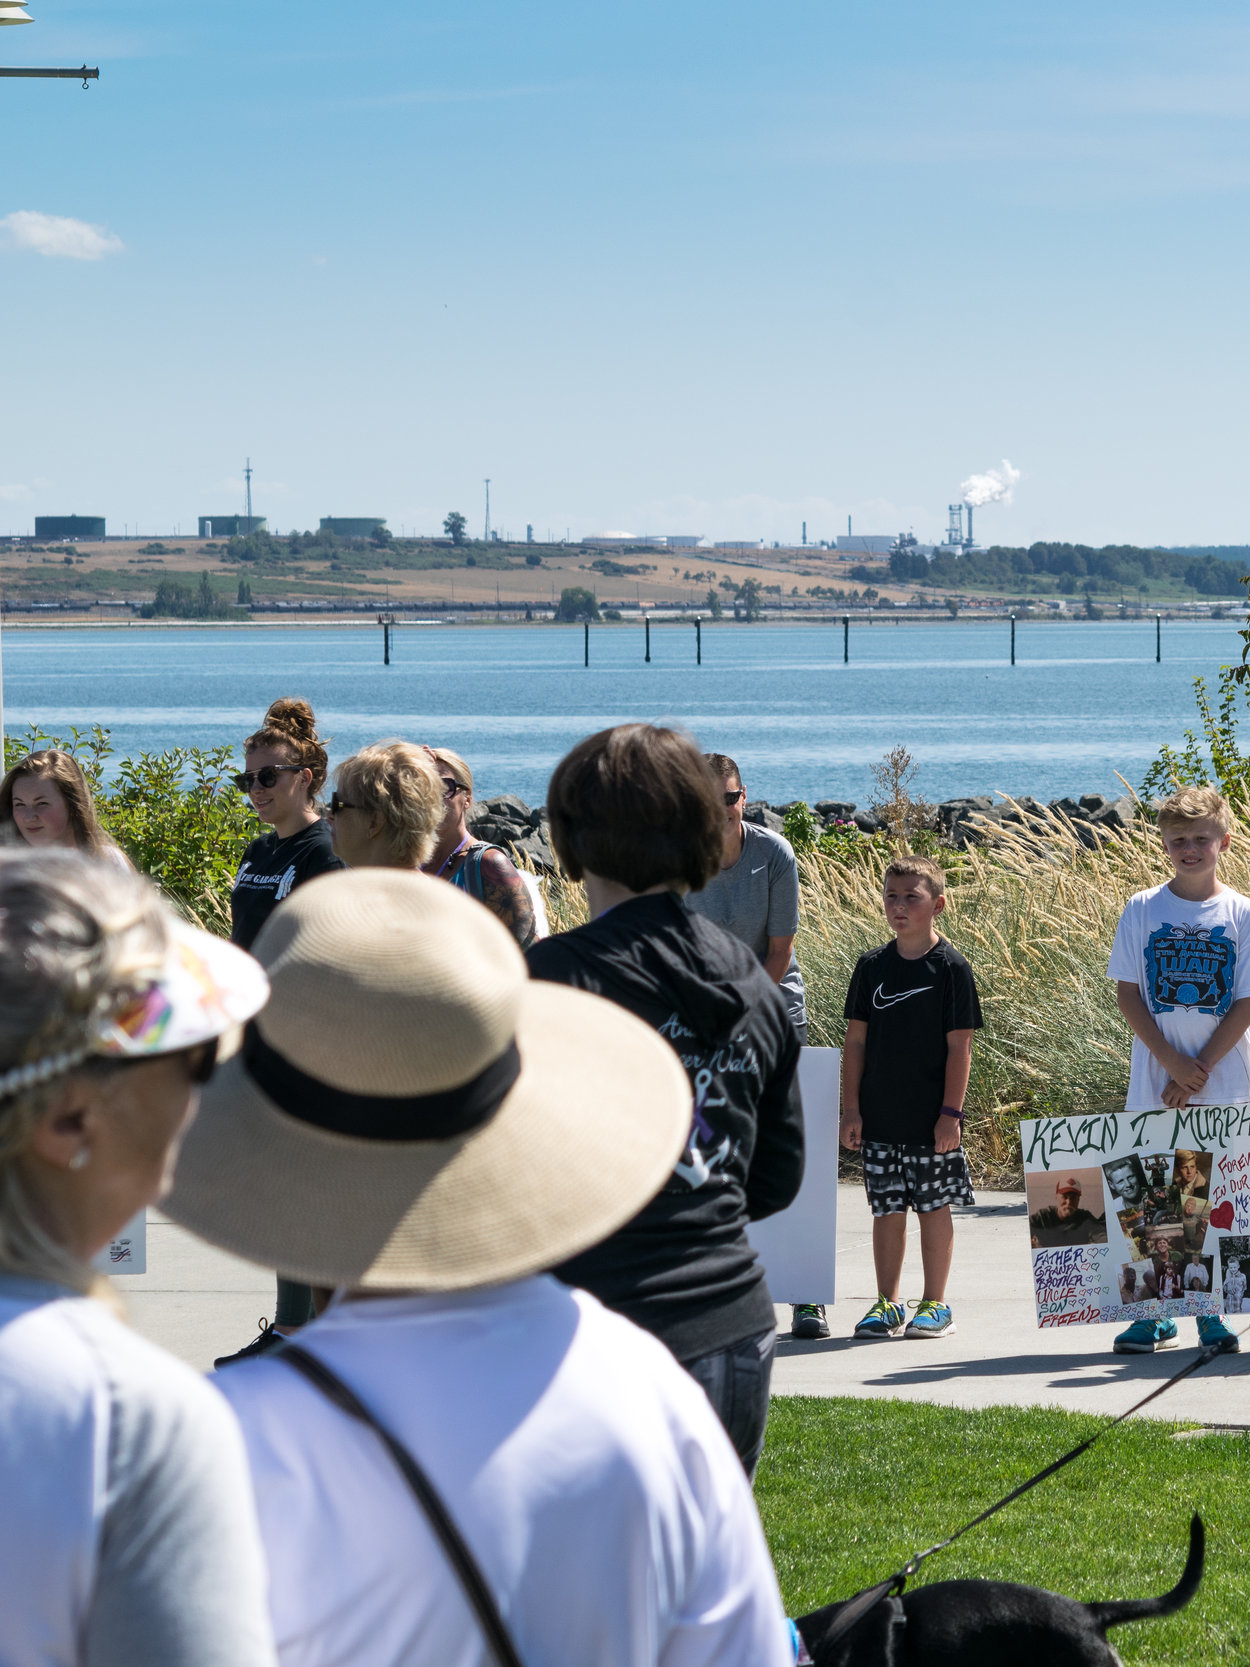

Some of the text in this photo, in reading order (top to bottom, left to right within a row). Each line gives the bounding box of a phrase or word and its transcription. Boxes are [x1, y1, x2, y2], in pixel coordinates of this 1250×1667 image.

[1173, 939, 1207, 951] WTA
[1160, 956, 1219, 975] LUAU
[1026, 1113, 1119, 1171] KEVIN
[1130, 1109, 1167, 1149] T.
[1212, 1184, 1227, 1206] IN
[1235, 1211, 1249, 1235] YOU
[1033, 1246, 1088, 1268] FATHER
[1036, 1272, 1086, 1294] BROTHER
[1037, 1287, 1078, 1304] UNCLE
[1038, 1304, 1101, 1329] FRIEND
[1039, 1298, 1068, 1319] SON
